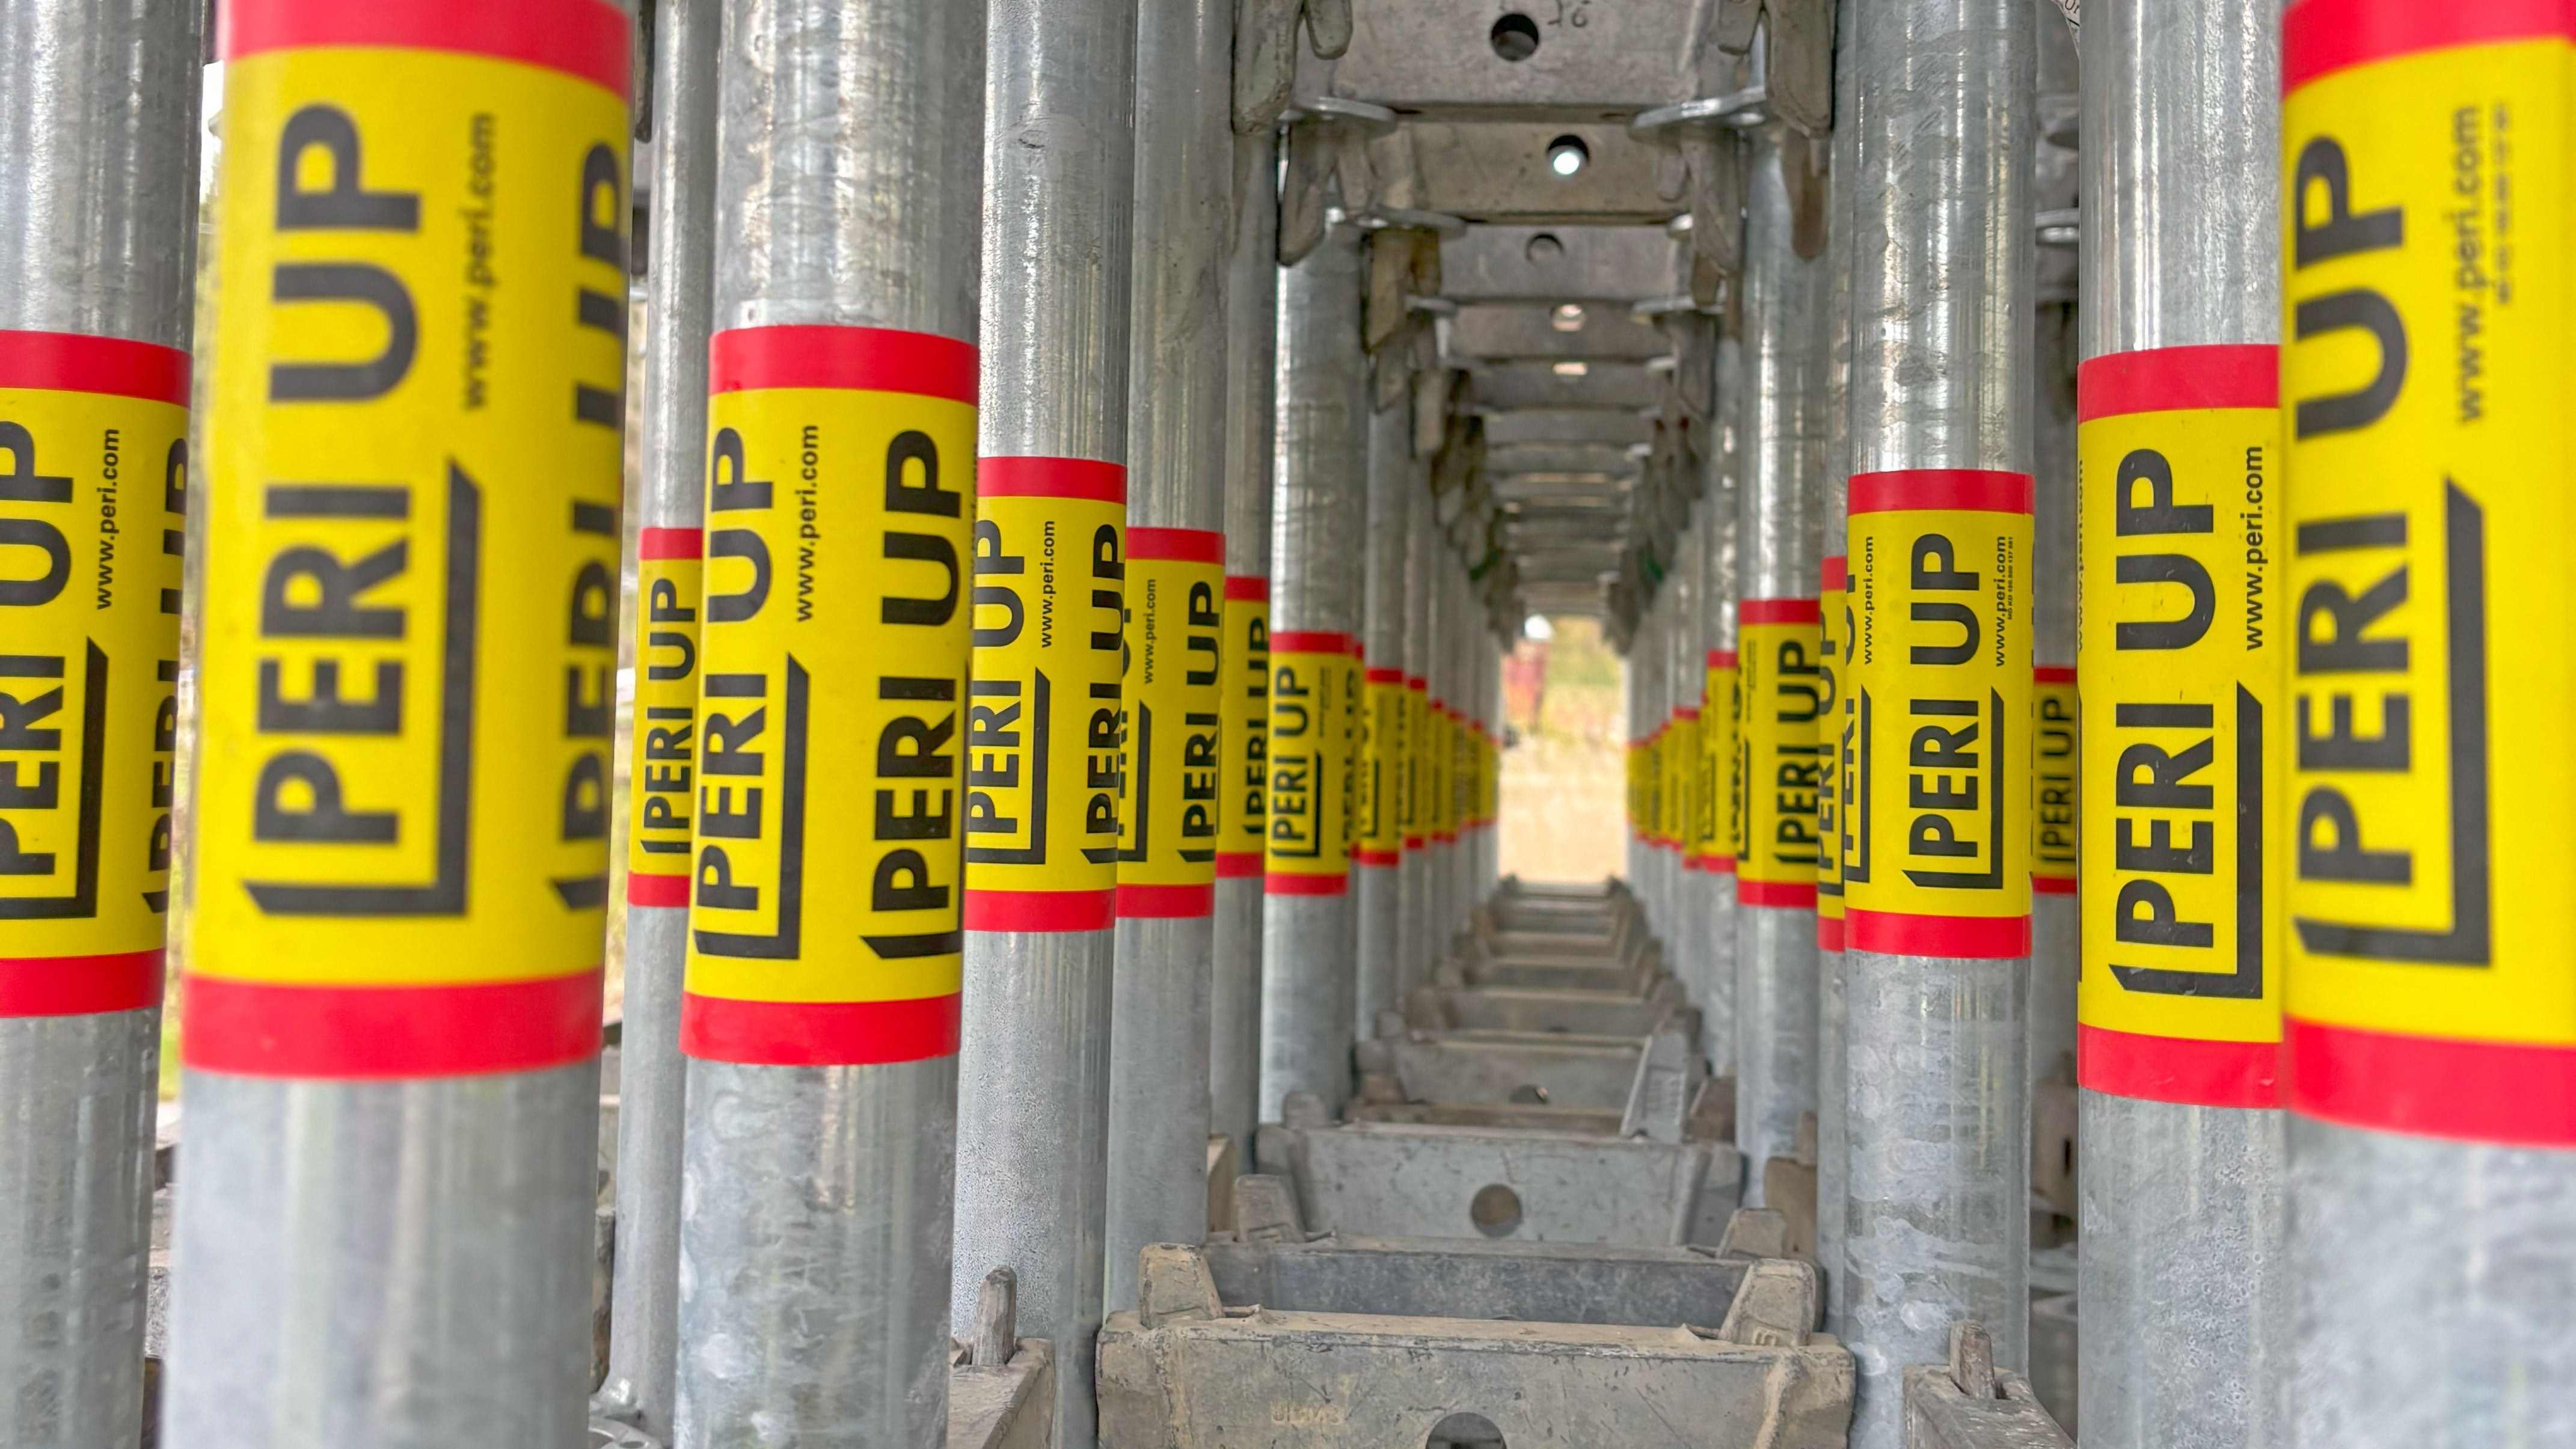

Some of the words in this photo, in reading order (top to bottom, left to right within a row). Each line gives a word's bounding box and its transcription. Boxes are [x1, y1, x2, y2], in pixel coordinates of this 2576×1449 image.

[269, 103, 423, 403] UP
[456, 112, 497, 412] www.peri.com
[2295, 135, 2409, 441] UP
[2445, 104, 2487, 424] www.peri.com
[0, 421, 73, 606] UP
[96, 428, 120, 610] www.peri.com
[707, 427, 773, 623] UP
[796, 425, 819, 622] www.peri.com
[881, 430, 962, 626] UP
[972, 519, 1025, 648] UP
[1040, 521, 1055, 648] www.peri.com
[1091, 524, 1125, 651] UP
[2115, 448, 2215, 651] UP
[2240, 446, 2269, 651] www.peri.com
[252, 485, 412, 845] PERI
[649, 578, 696, 681] UP
[1144, 579, 1156, 684] www.peri.com
[1186, 581, 1221, 685] UP
[1863, 536, 1874, 666] www.peri.com
[1910, 533, 1980, 666] UP
[1993, 536, 2007, 667] www.peri.com
[968, 681, 1021, 833] PERI
[1274, 666, 1310, 738] UP
[1777, 639, 1820, 724] UP
[2041, 699, 2073, 756] UP
[2296, 511, 2414, 886] PERI
[0, 656, 65, 875] PERI
[643, 708, 693, 829] PERI
[697, 673, 767, 910] PERI
[871, 676, 956, 911] PERI
[1086, 682, 1121, 834] PERI
[1183, 713, 1218, 838] PERI
[1245, 719, 1267, 814] PERI
[1272, 755, 1307, 841] PERI
[1776, 744, 1819, 845] PERI
[1909, 699, 1979, 857] PERI
[2041, 777, 2072, 846] PERI
[2115, 703, 2214, 948] PERI
